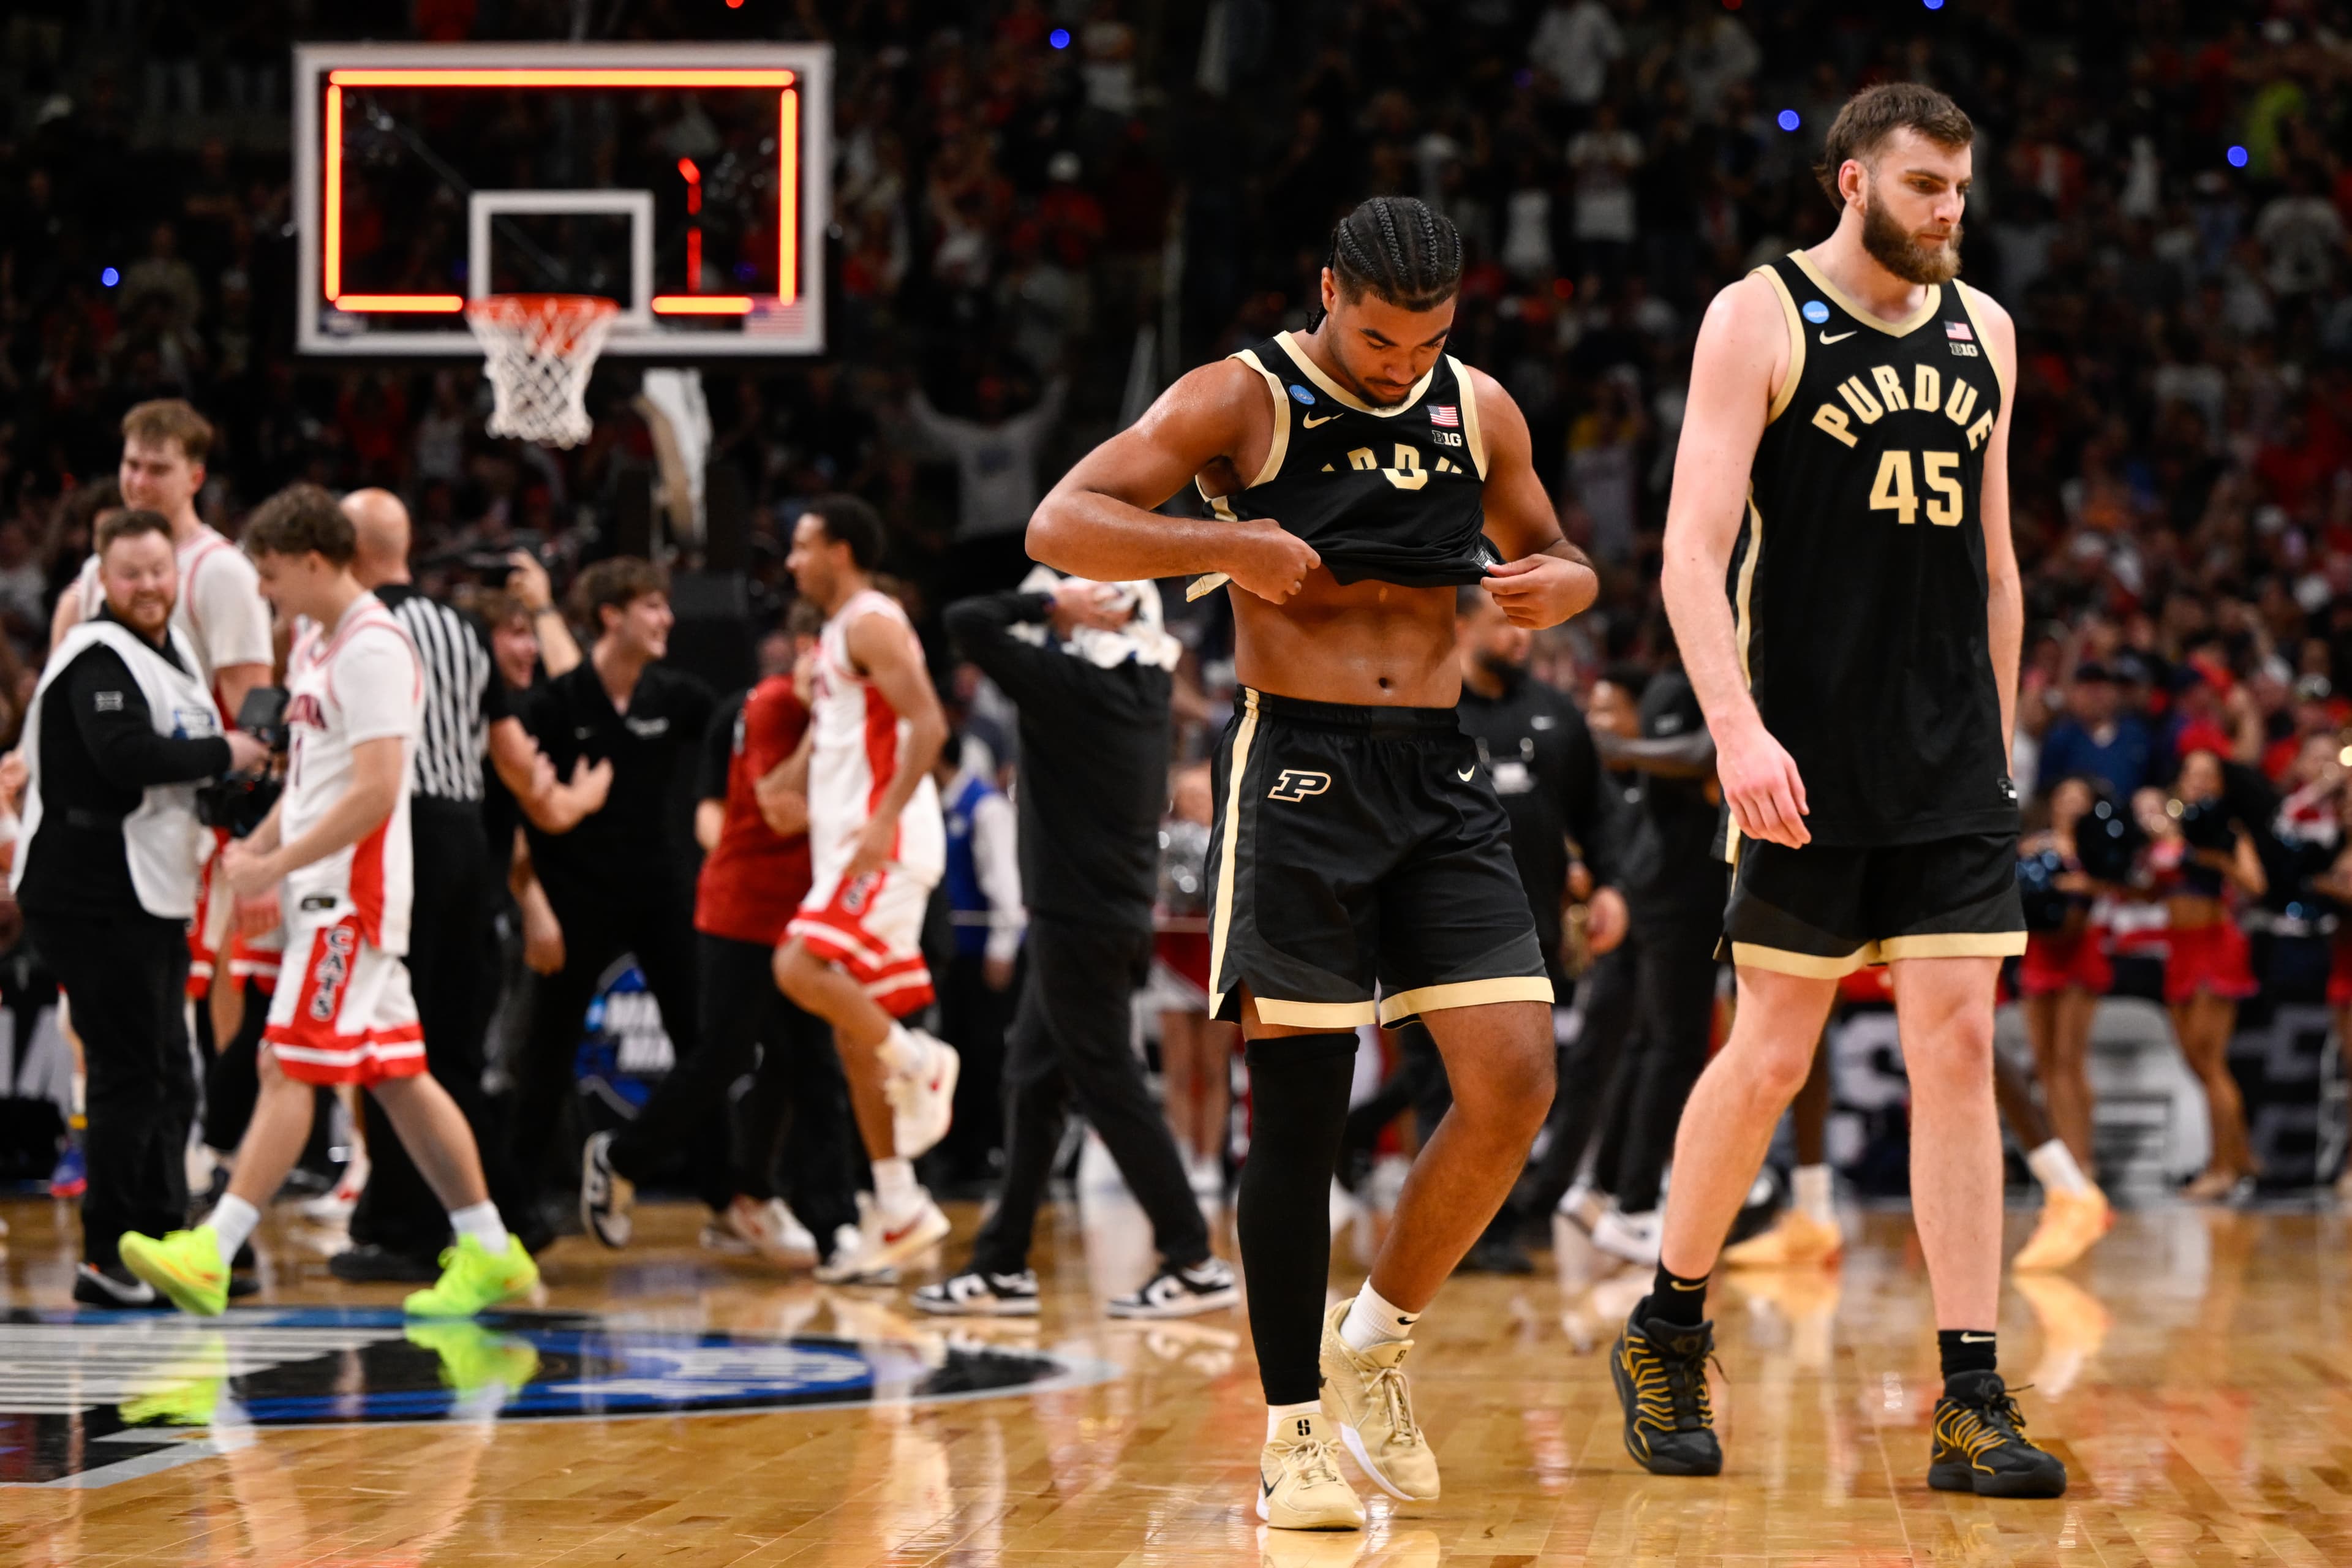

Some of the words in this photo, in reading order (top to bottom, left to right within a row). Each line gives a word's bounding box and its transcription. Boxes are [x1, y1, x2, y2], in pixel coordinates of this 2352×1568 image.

[1812, 364, 1994, 451] PURDUE
[1869, 450, 1963, 527] 45
[1267, 769, 1332, 802] P
